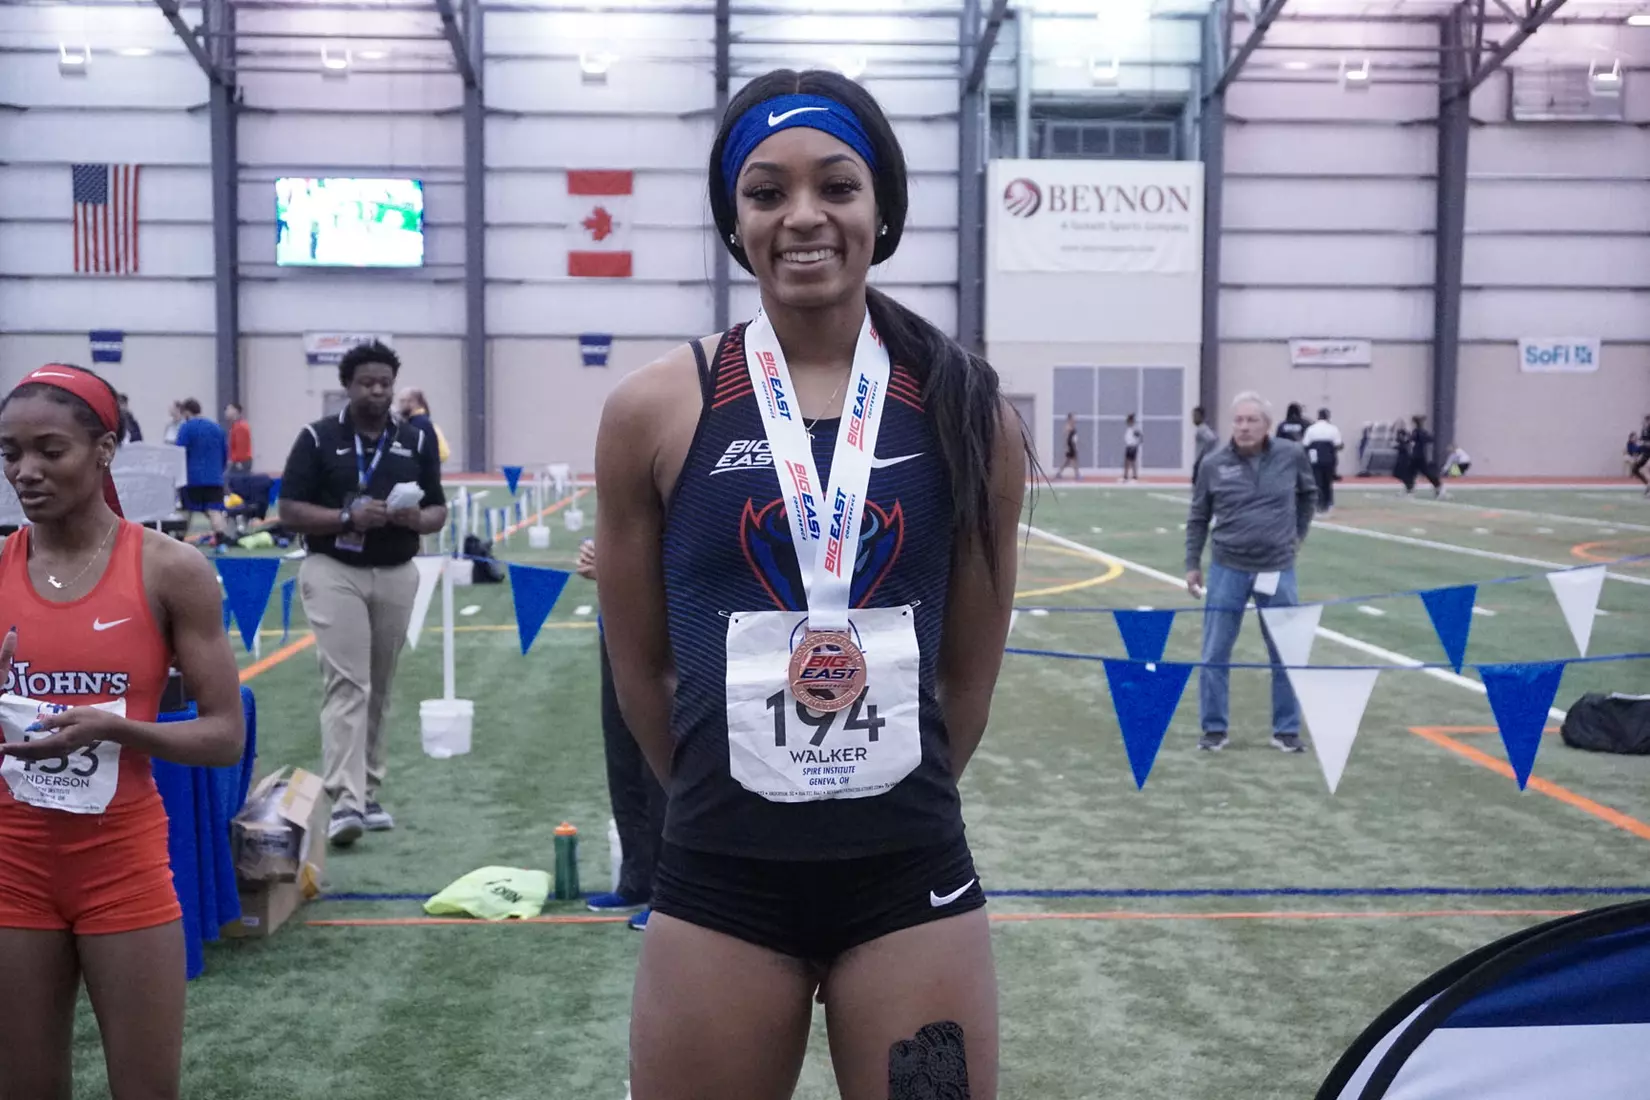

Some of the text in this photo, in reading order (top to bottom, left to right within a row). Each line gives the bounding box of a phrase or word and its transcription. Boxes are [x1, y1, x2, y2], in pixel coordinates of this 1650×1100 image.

[1048, 184, 1191, 213] BEYNON
[1525, 344, 1569, 365] SoFi
[761, 381, 776, 419] CONFERENCE
[867, 381, 878, 419] CONFERENCE
[724, 440, 771, 453] BIG
[715, 453, 773, 467] EAS
[792, 495, 807, 541] CONFERENCE
[845, 494, 856, 539] CONFERENCE
[807, 656, 849, 667] BIG
[801, 668, 860, 679] EAST
[766, 686, 886, 747] 194
[789, 747, 867, 764] WALKER
[802, 765, 856, 776] SPIRE INSTITUTE
[25, 774, 90, 788] NDERSON
[809, 776, 850, 786] GENEVA, OH
